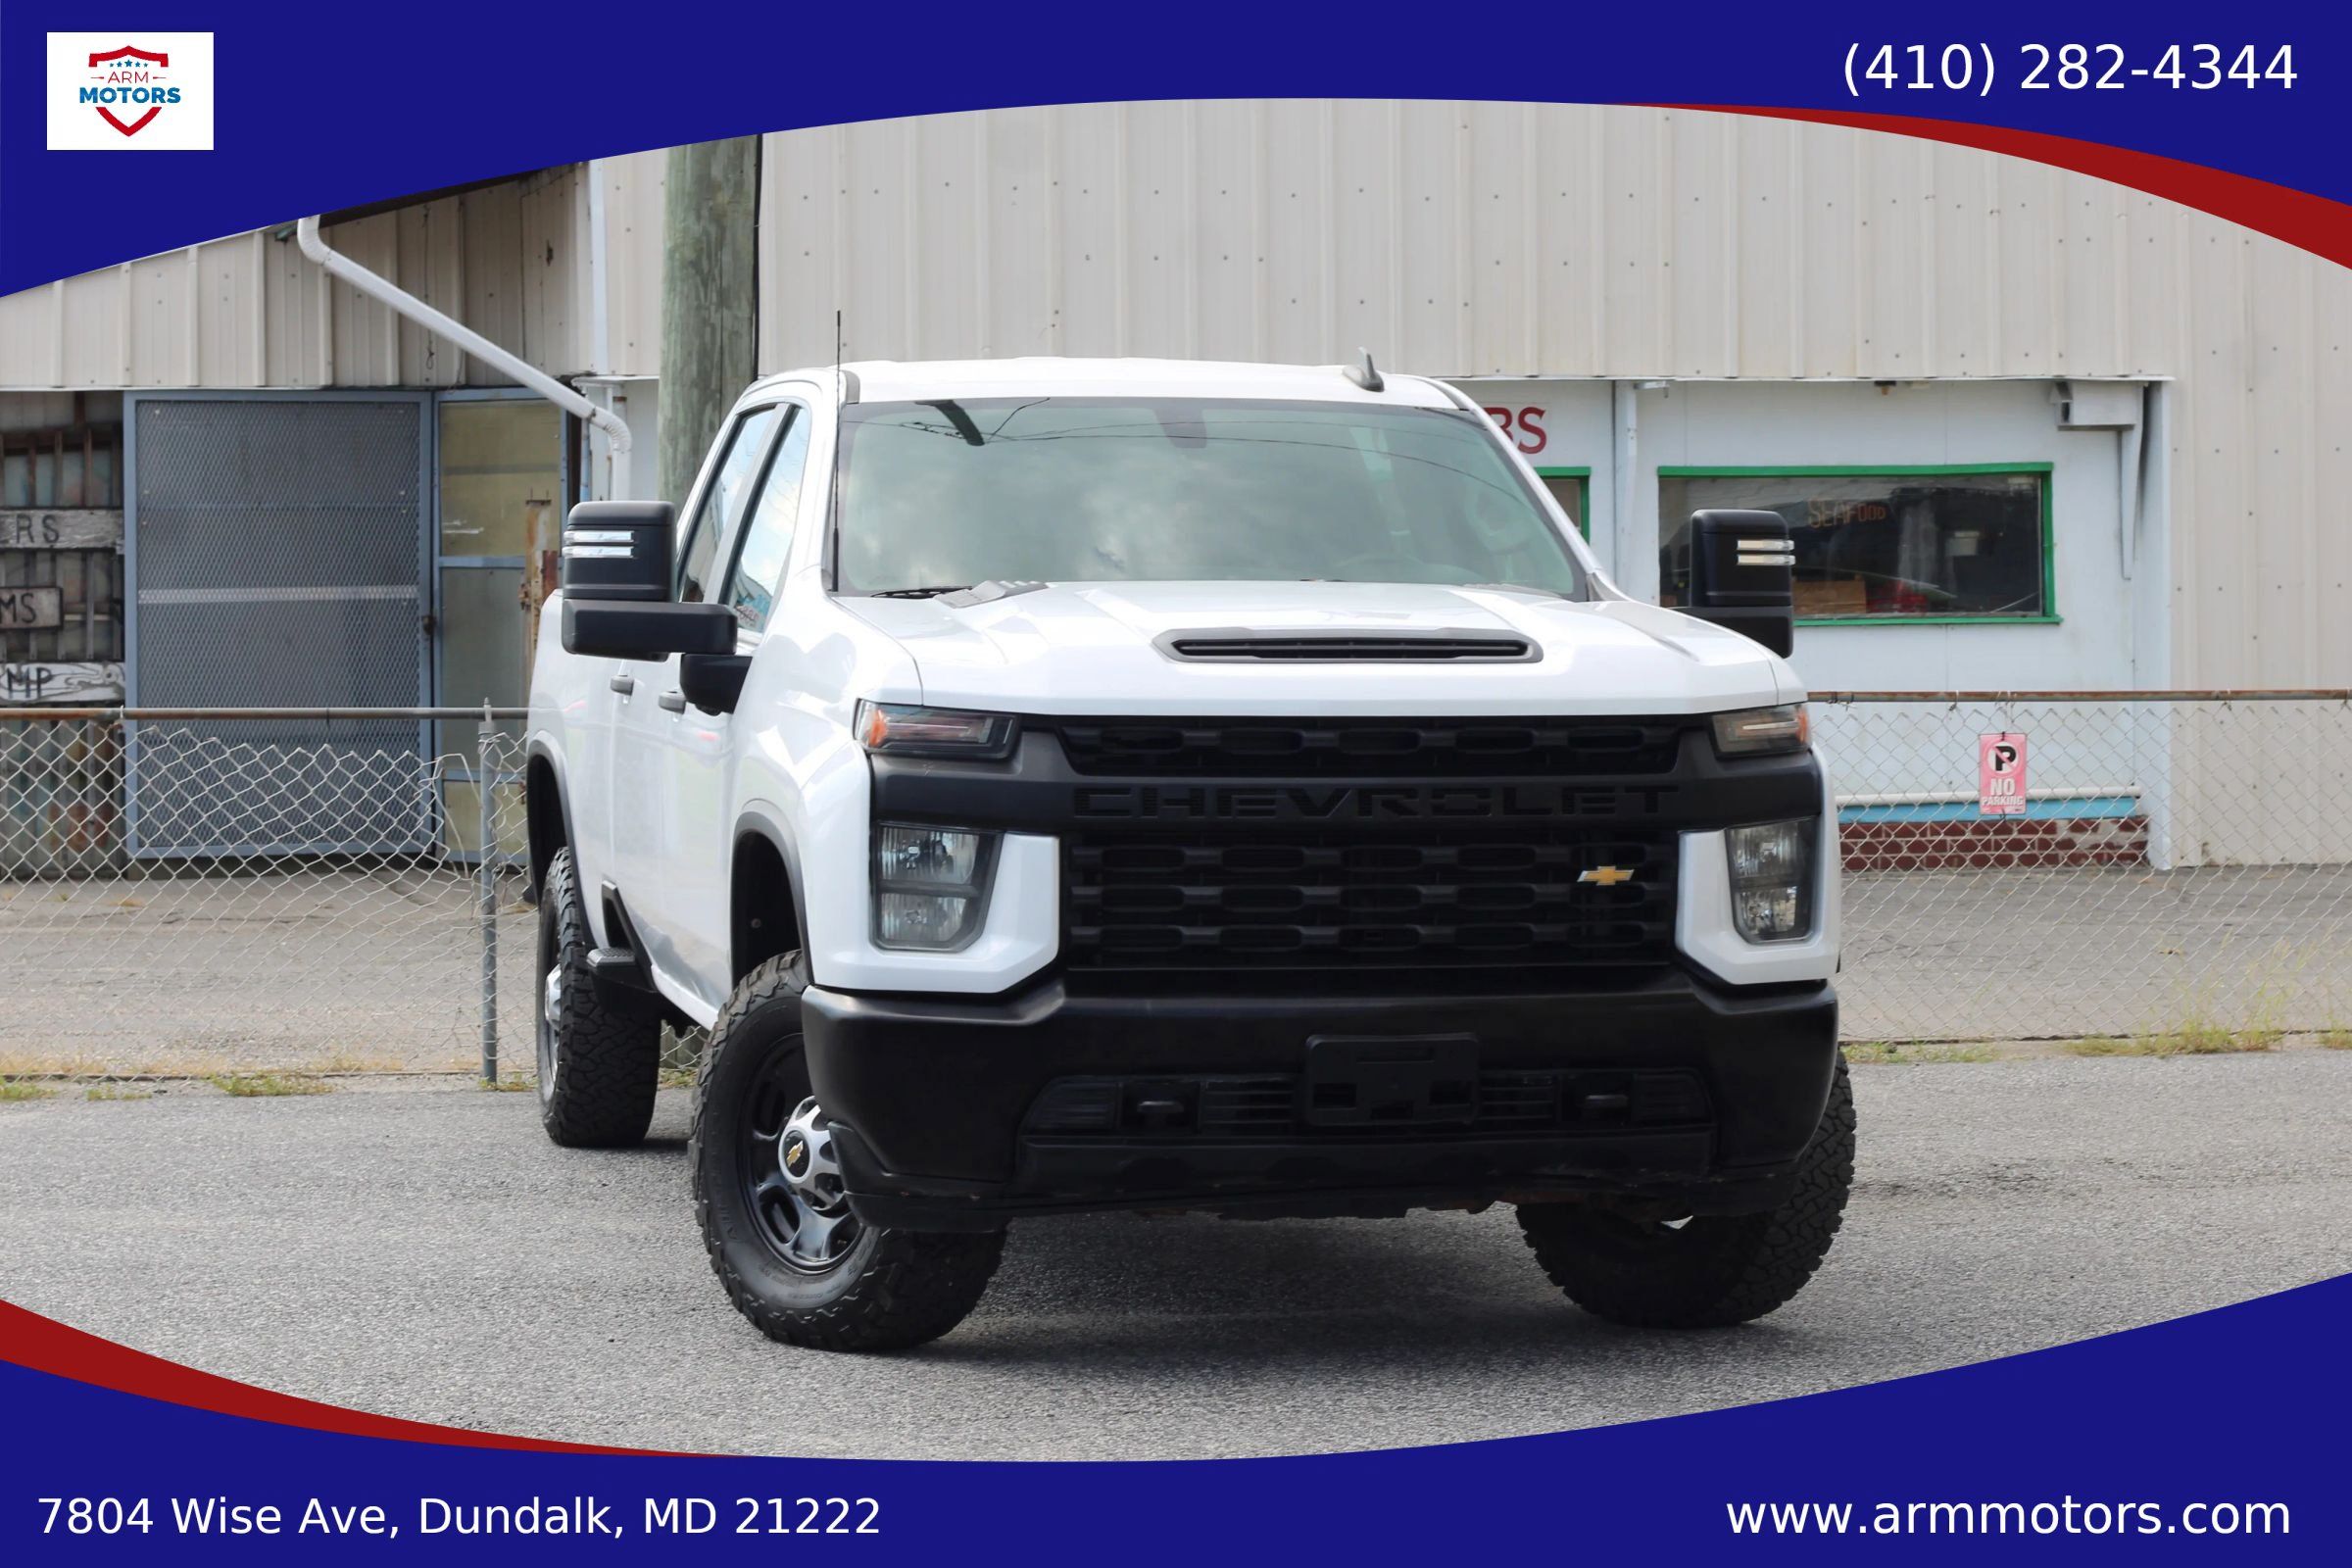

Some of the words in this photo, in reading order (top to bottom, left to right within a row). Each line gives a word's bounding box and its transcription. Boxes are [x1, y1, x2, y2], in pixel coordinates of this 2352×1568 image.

[1807, 499, 1886, 528] SEAFOOD
[1990, 778, 2015, 796] NO
[1074, 786, 1680, 818] CHEVROLET
[1982, 796, 2023, 807] PARKING
